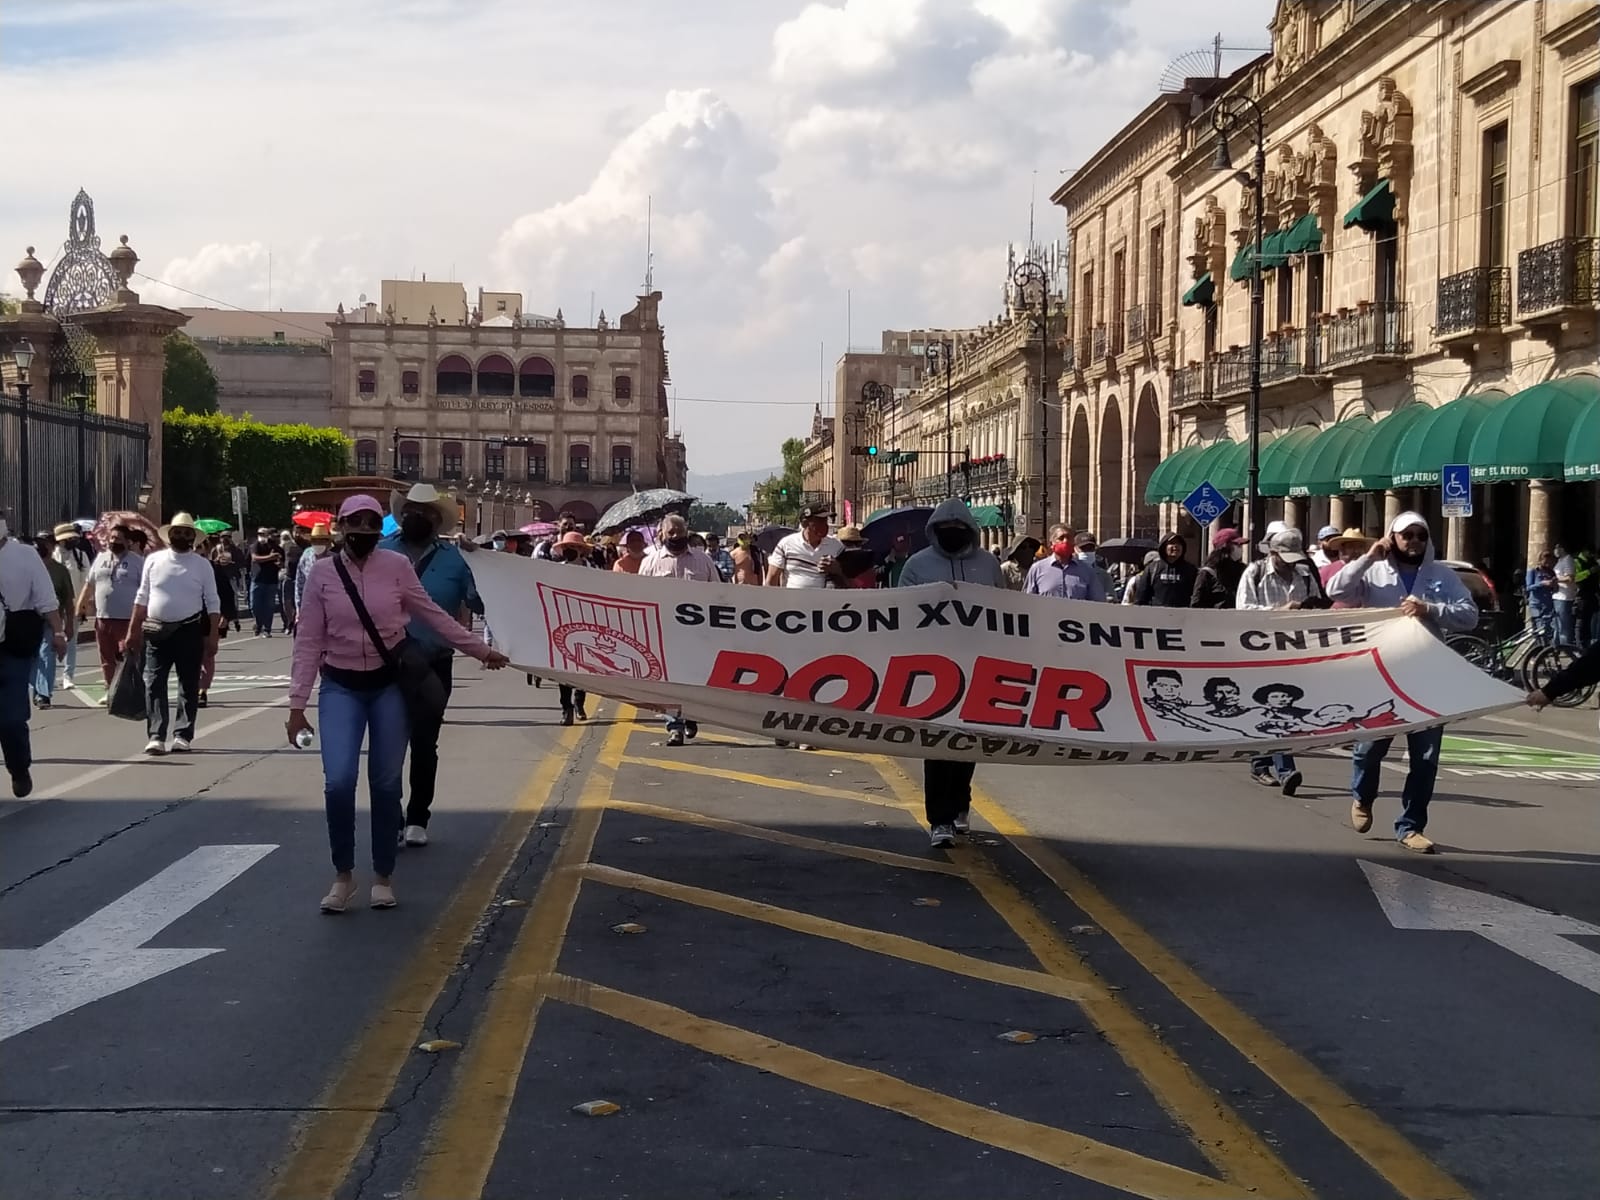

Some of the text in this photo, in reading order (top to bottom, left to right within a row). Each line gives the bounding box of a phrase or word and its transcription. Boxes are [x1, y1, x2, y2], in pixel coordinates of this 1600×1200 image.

[1413, 472, 1439, 481] ATRIO
[1489, 466, 1499, 476] EL
[1500, 465, 1529, 476] ATRIO
[1202, 487, 1210, 497] E
[675, 603, 900, 634] SECCIÓN
[916, 600, 1030, 637] XVIII
[1058, 620, 1186, 651] SNTE
[1239, 625, 1367, 651] CNTE
[605, 627, 647, 653] SERVICIO
[706, 650, 1112, 732] PODER
